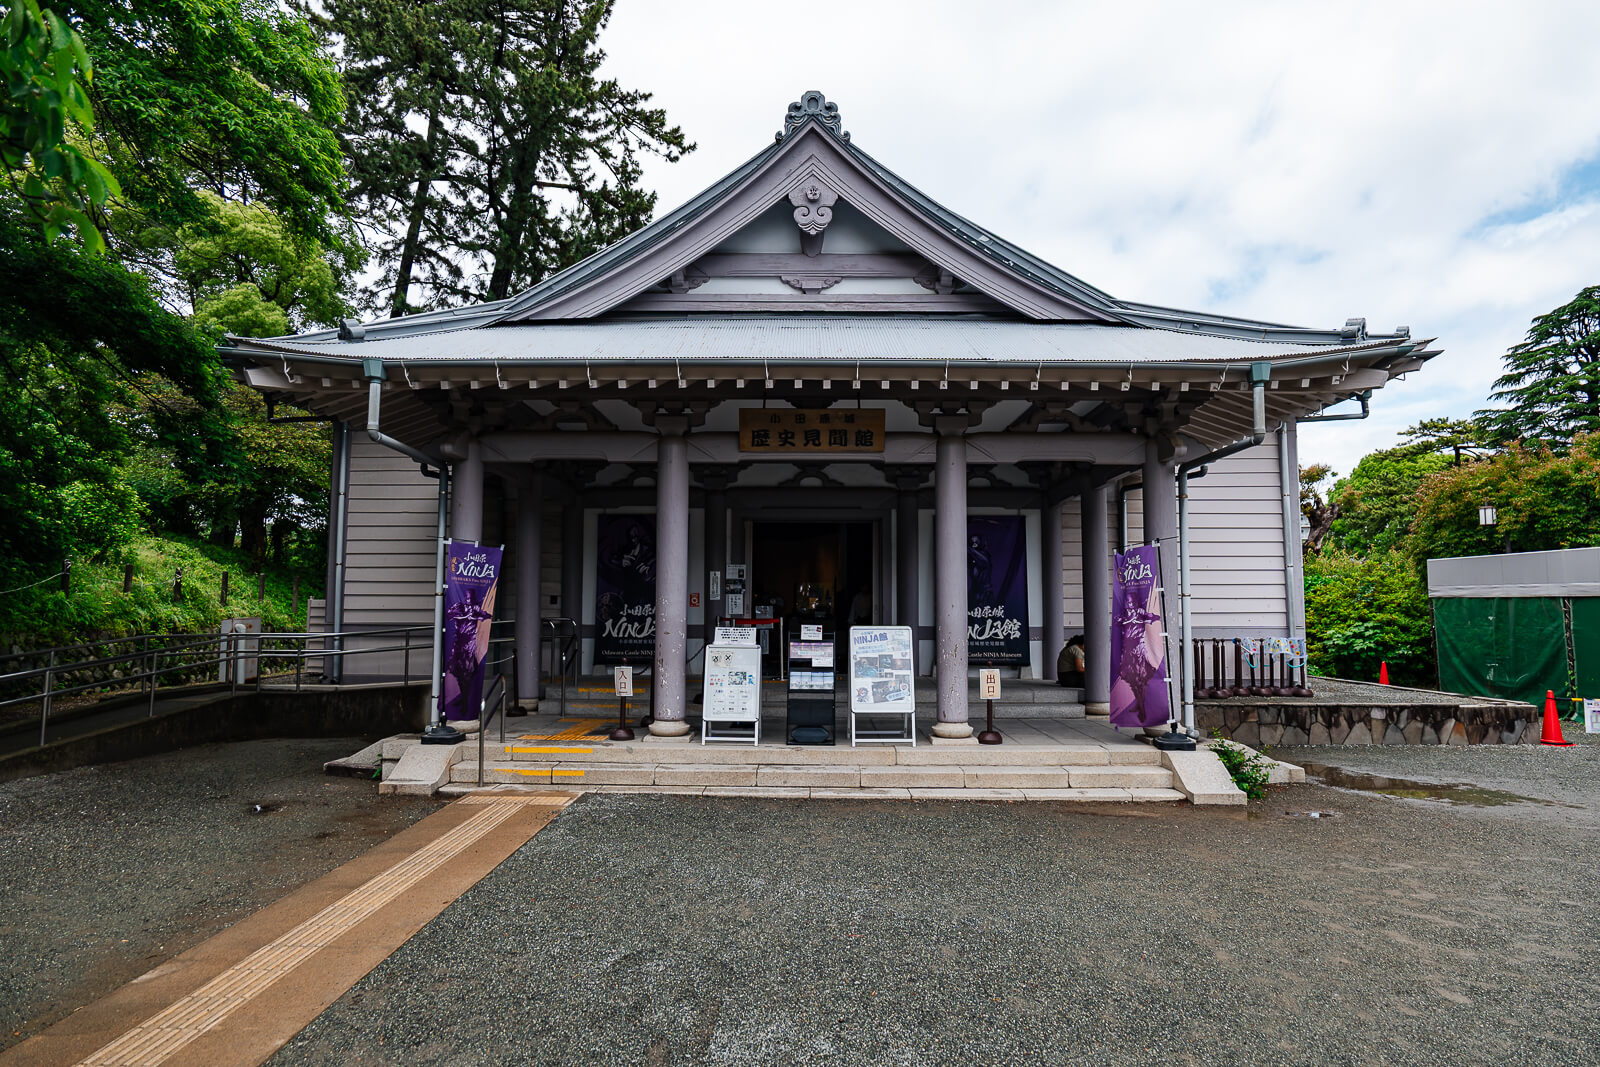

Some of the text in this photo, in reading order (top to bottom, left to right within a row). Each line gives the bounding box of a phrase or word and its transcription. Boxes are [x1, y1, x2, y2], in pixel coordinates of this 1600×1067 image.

[751, 429, 874, 447] 歴史見聞館
[456, 561, 495, 578] NINJA
[967, 605, 1005, 618] 田原城
[618, 670, 628, 689] 入口
[986, 674, 996, 694] 出口
